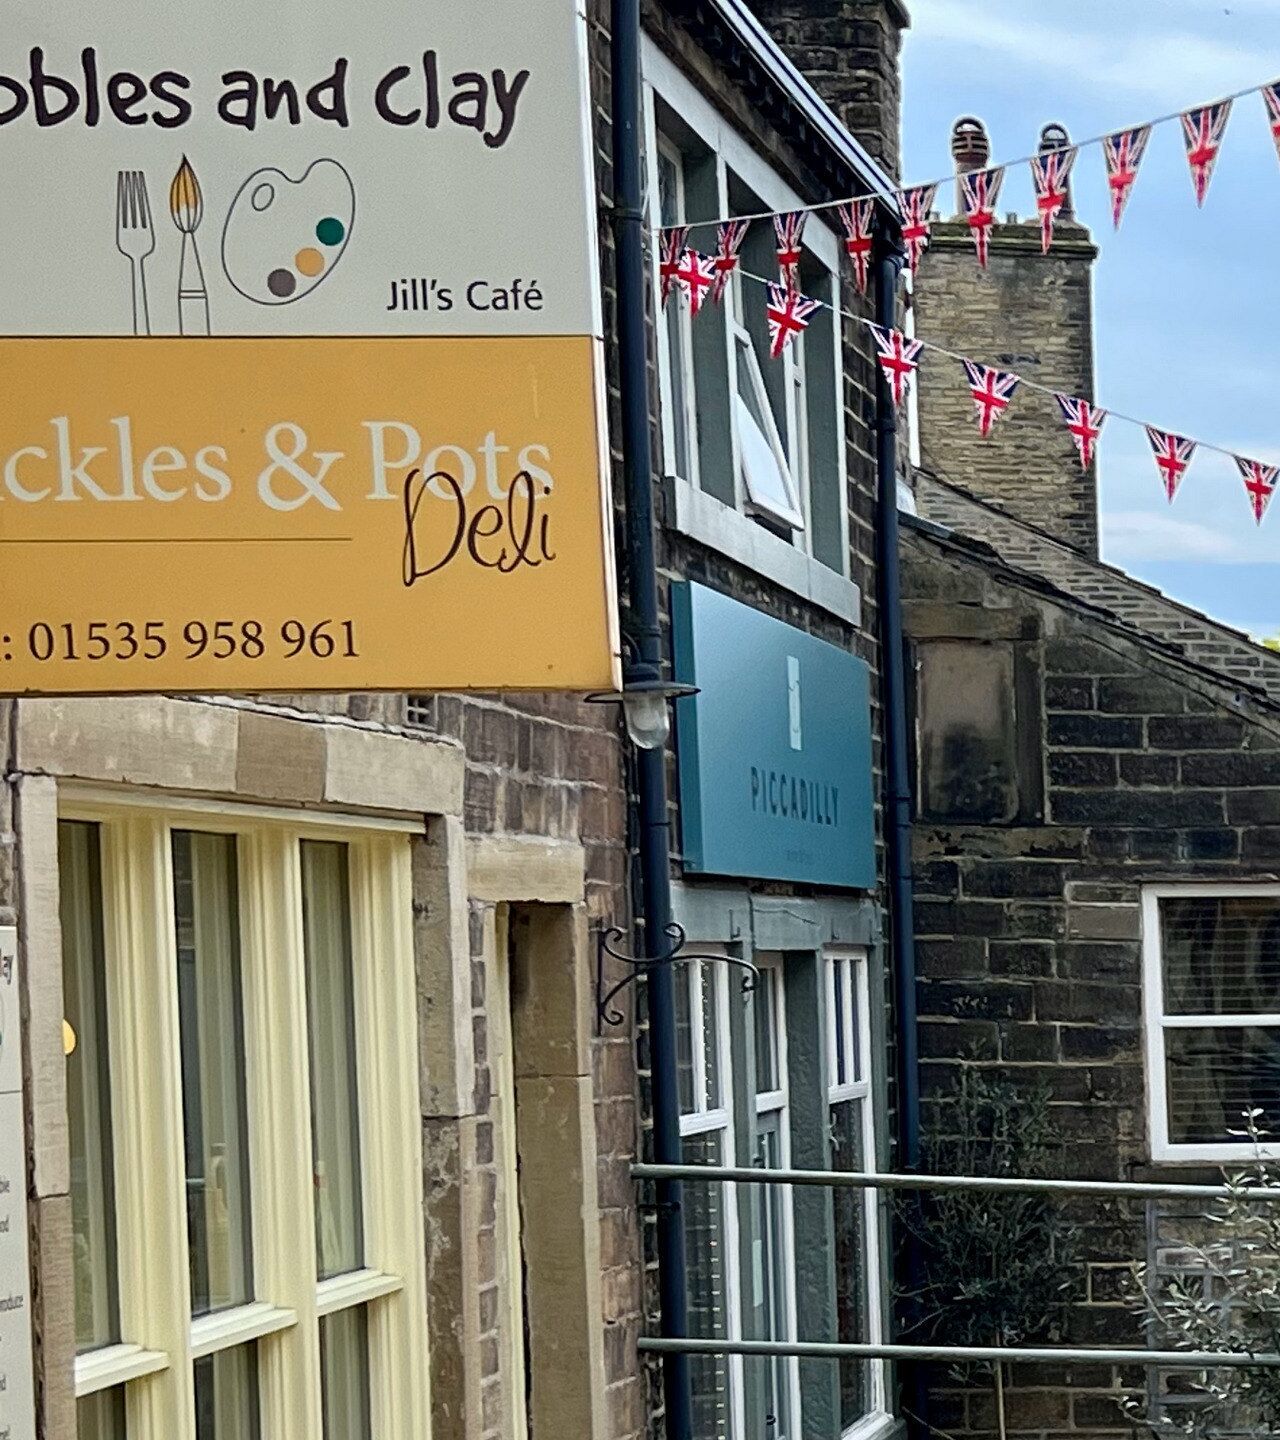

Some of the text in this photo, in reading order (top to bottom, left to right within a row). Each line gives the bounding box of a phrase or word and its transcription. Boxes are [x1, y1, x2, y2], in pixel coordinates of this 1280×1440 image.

[218, 58, 348, 131] and
[375, 50, 530, 148] clay
[387, 279, 543, 311] Jill's Café
[0, 416, 554, 512] ckles & Pots
[402, 468, 556, 588] Deli
[29, 621, 166, 661] 01535
[184, 620, 265, 660] 958
[281, 619, 360, 659] 961
[750, 766, 840, 828] PICCADILLY
